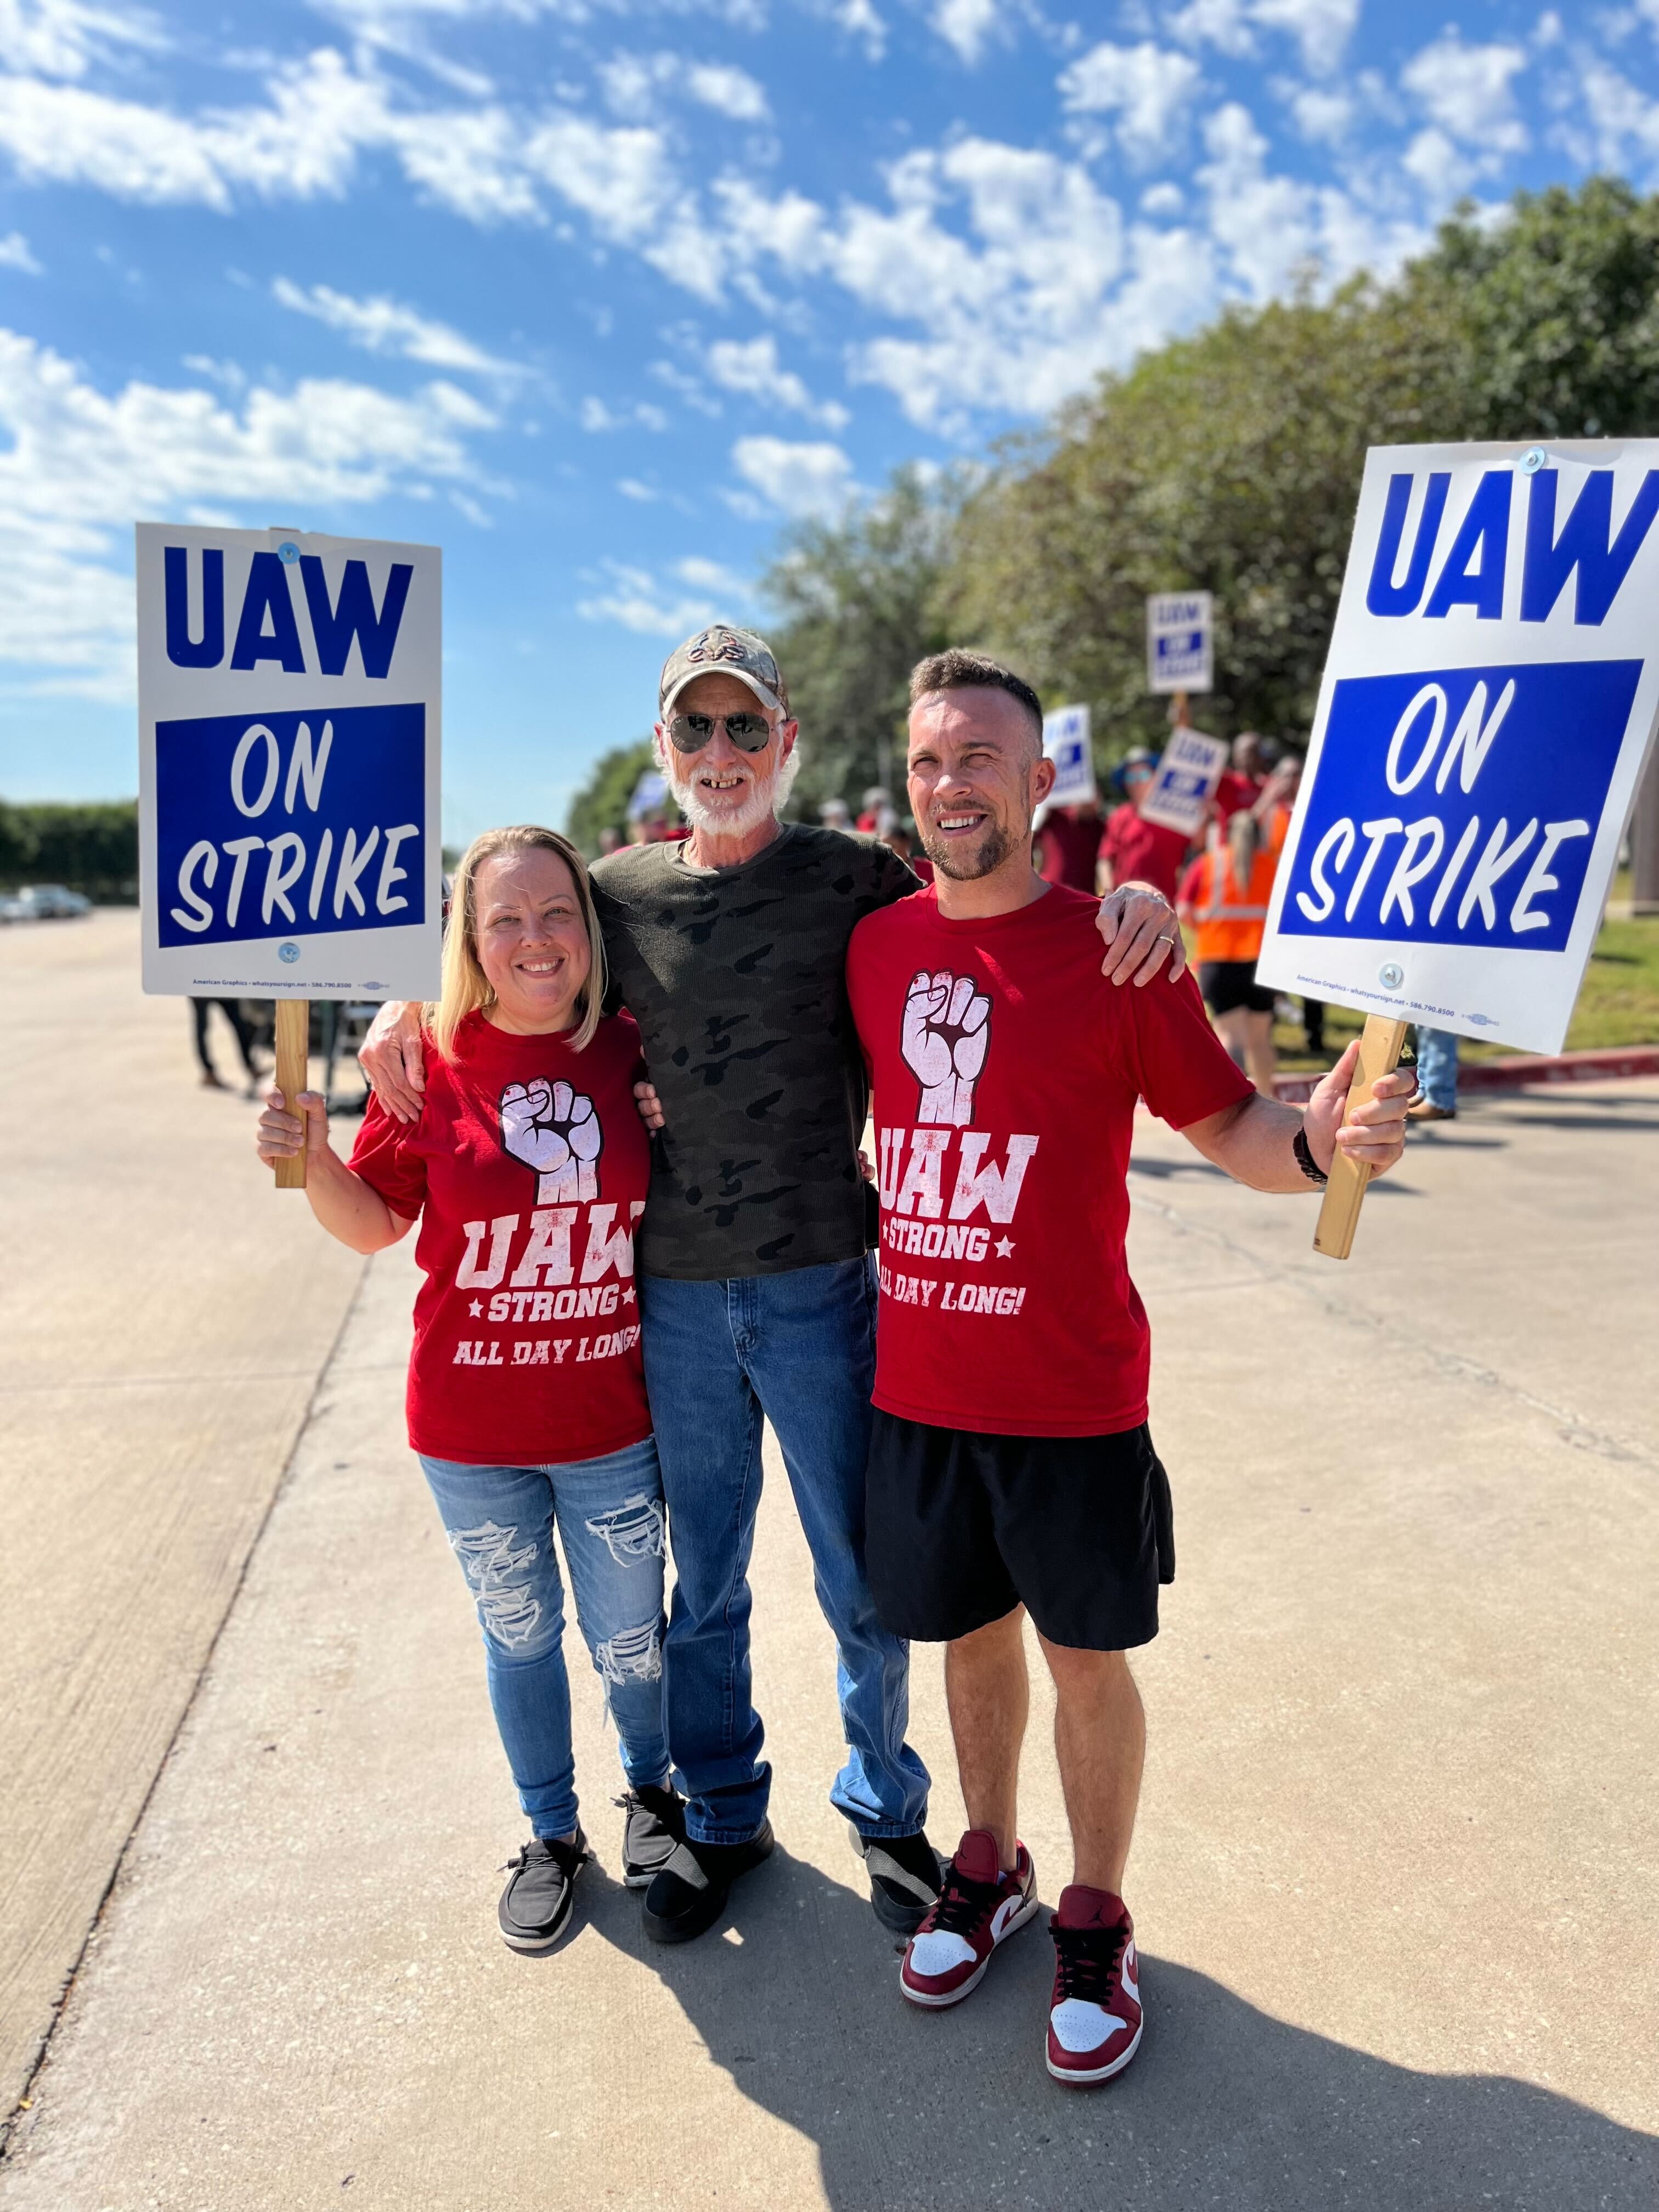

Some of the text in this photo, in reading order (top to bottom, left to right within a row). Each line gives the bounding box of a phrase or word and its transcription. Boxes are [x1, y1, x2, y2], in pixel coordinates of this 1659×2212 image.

[1366, 469, 1659, 627] UAW
[165, 546, 414, 679] UAW
[231, 720, 333, 817] ON
[1386, 679, 1515, 795] ON
[171, 824, 419, 933] STRIKE
[1295, 816, 1589, 933] STRIKE
[1296, 974, 1454, 1017] American Graphics whatsyoursign.net 586.790.8500
[880, 1128, 1040, 1224] UAW
[455, 1200, 646, 1290] UAW
[888, 1217, 991, 1262] STRONG
[488, 1284, 620, 1322] STRONG
[893, 1273, 937, 1307] DAY
[940, 1282, 1026, 1315] LONG!
[453, 1323, 641, 1365] ALL DAY LONG!
